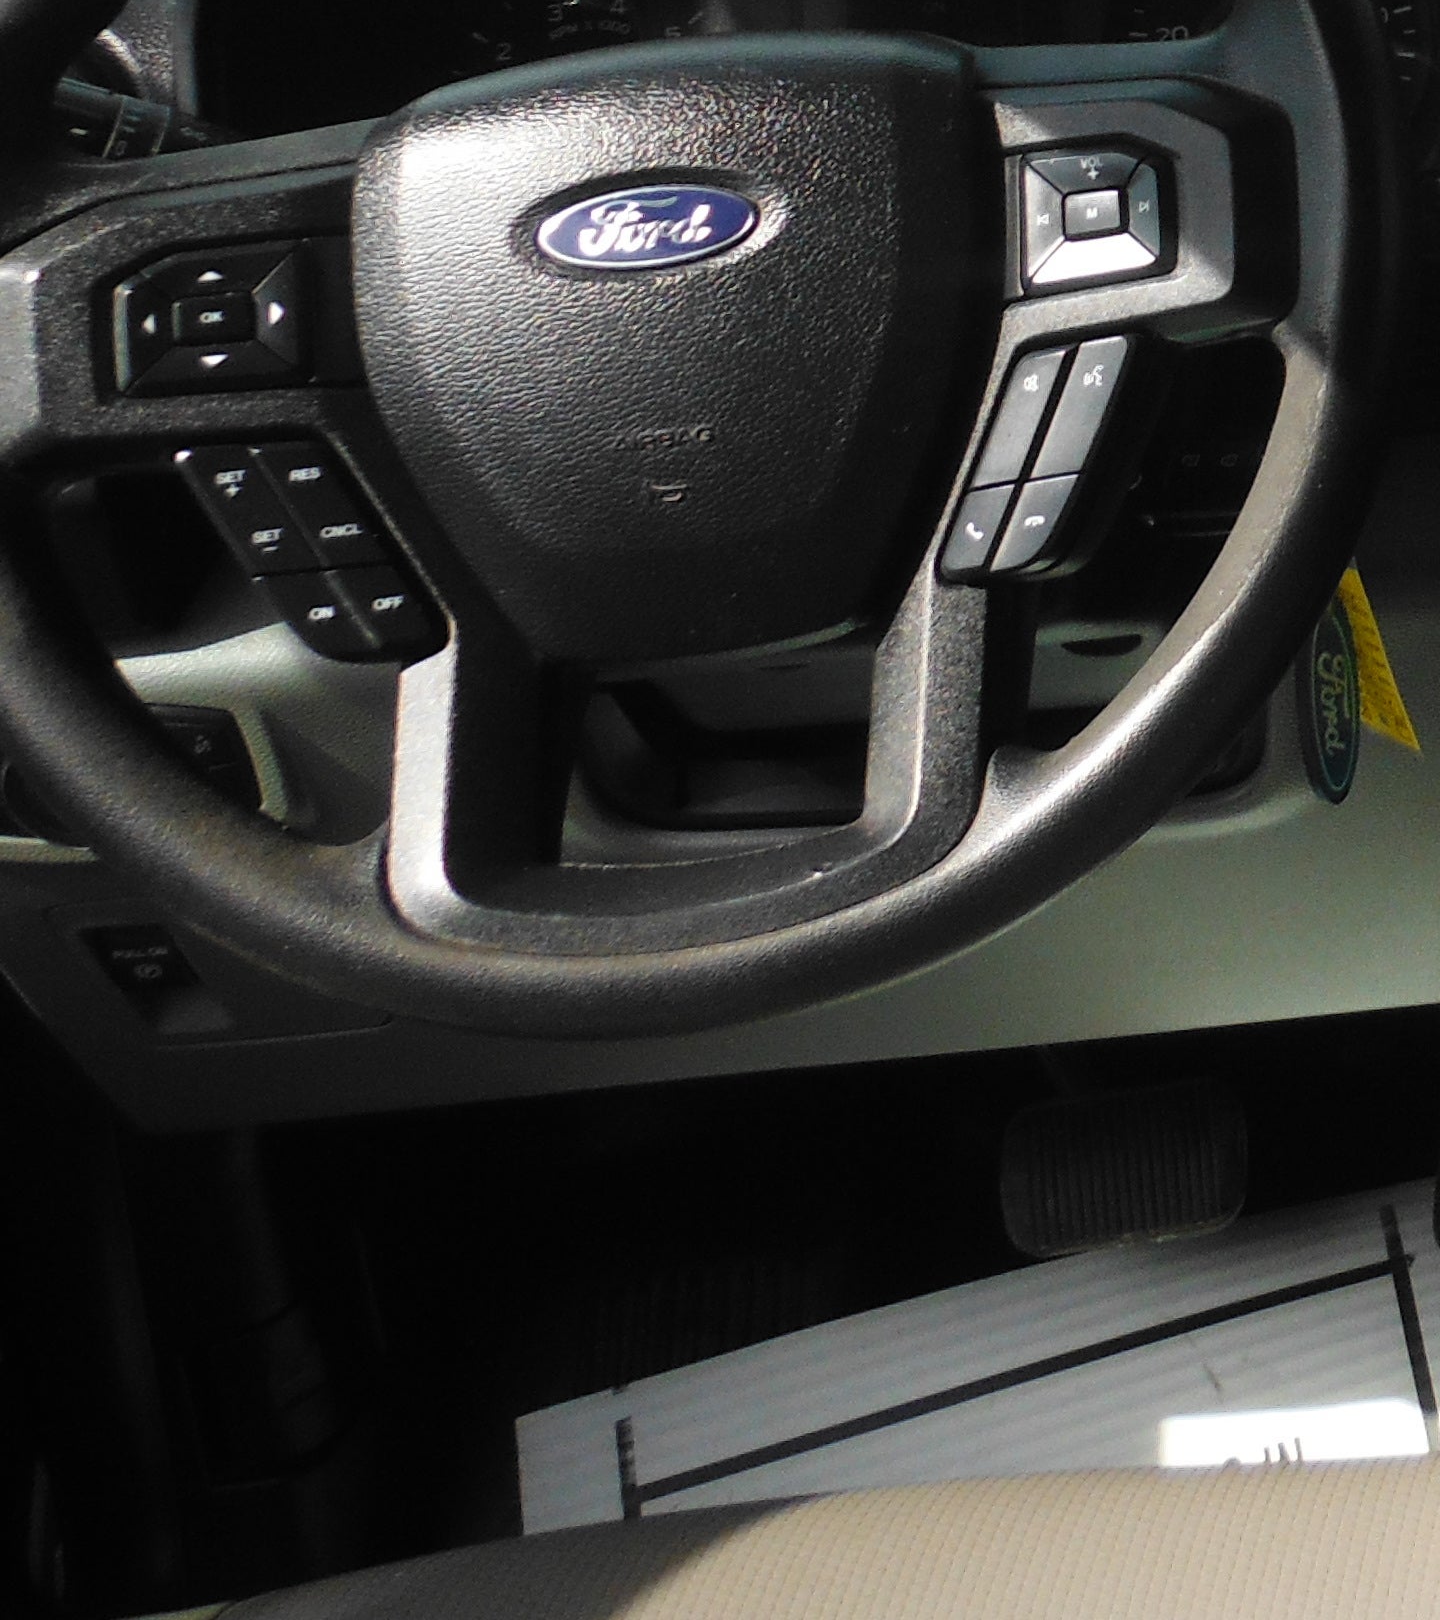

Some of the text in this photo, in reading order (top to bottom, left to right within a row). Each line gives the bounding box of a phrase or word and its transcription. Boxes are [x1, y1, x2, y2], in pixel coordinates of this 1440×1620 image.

[548, 4, 564, 22] 3
[496, 43, 511, 60] 2
[1080, 157, 1104, 168] VOL
[1086, 208, 1098, 219] M
[578, 195, 713, 257] Ford
[201, 311, 223, 324] OK
[215, 470, 246, 483] SET
[288, 467, 322, 481] RES
[251, 528, 284, 544] SET
[319, 523, 363, 538] CNCL
[371, 595, 404, 611] OFF
[308, 606, 336, 620] ON
[1317, 651, 1352, 756] Ford
